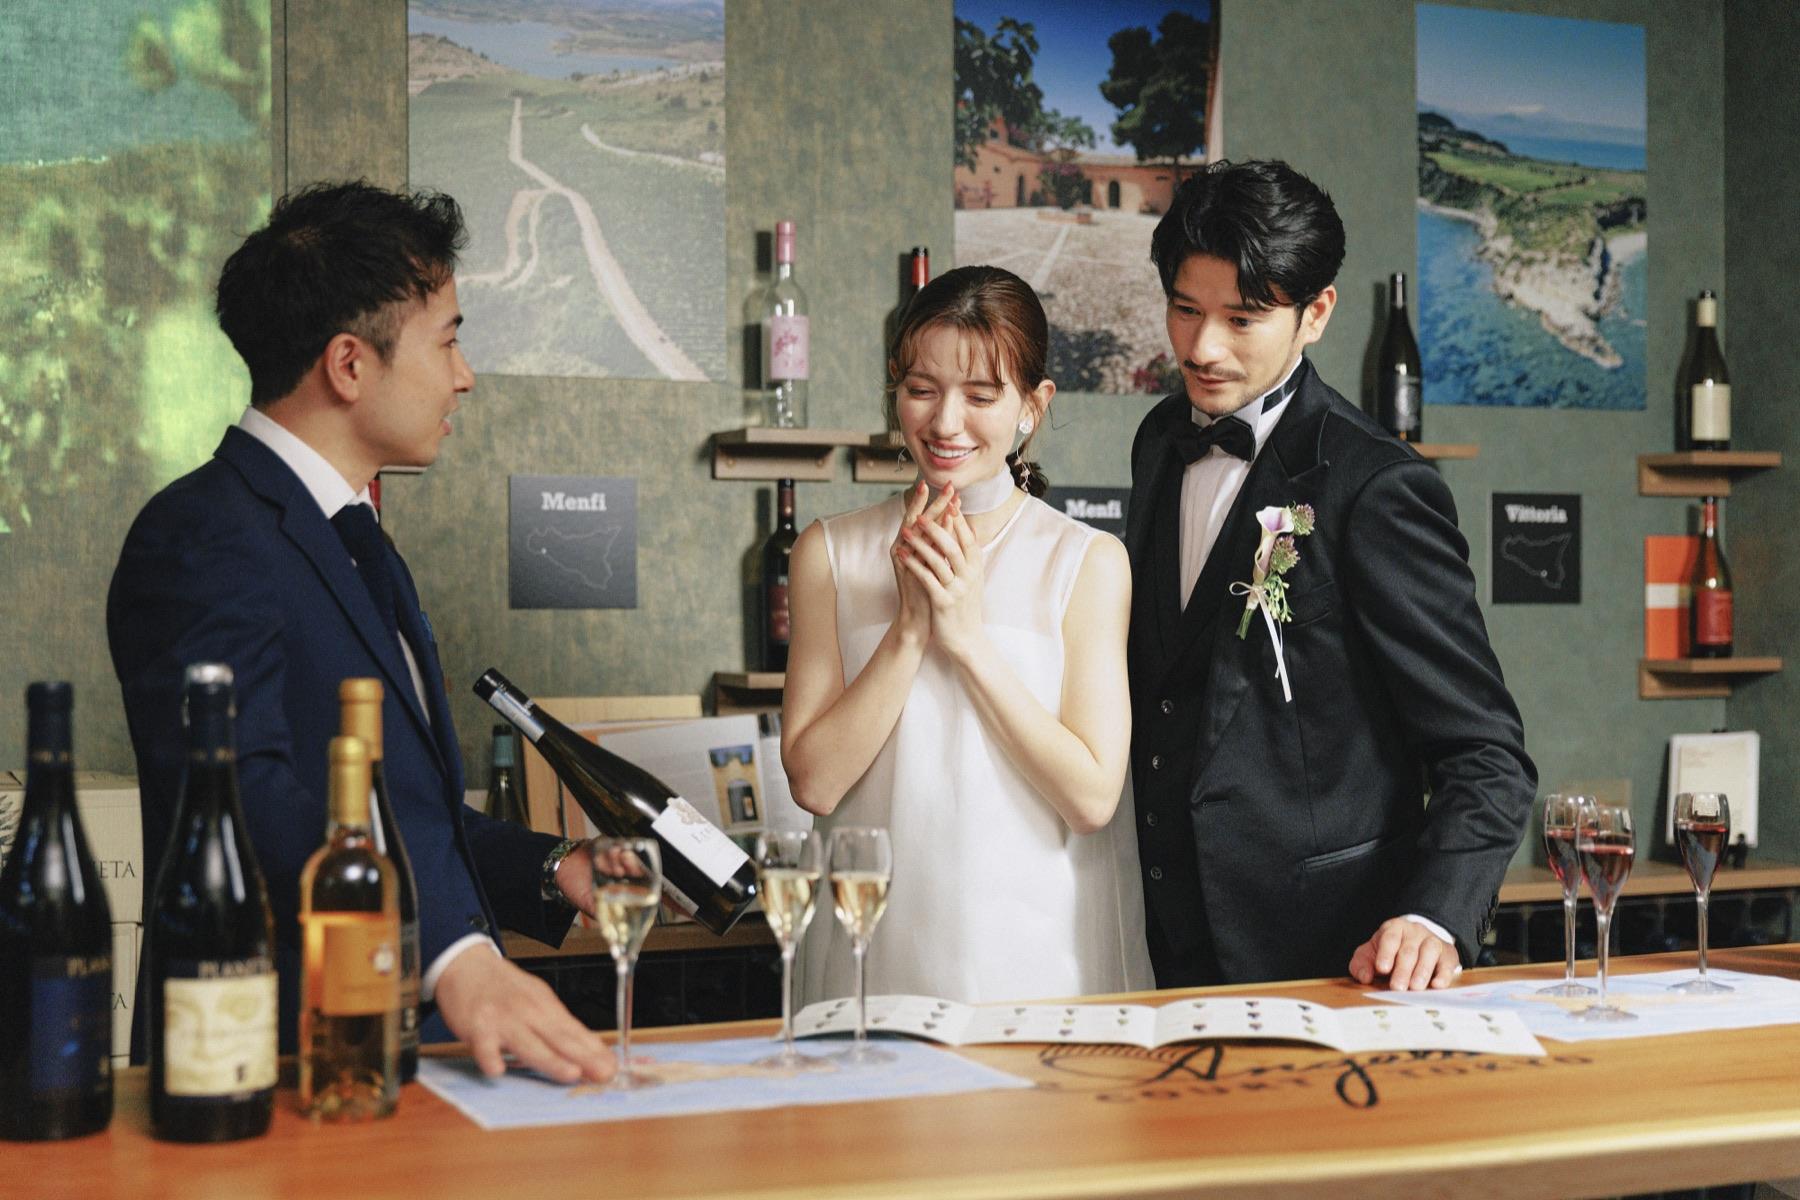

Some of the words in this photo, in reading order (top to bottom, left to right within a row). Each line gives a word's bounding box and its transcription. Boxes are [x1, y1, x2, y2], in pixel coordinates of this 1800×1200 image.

[541, 491, 607, 512] Menfi
[1065, 499, 1122, 519] Menfi
[1504, 503, 1568, 523] Vittoria
